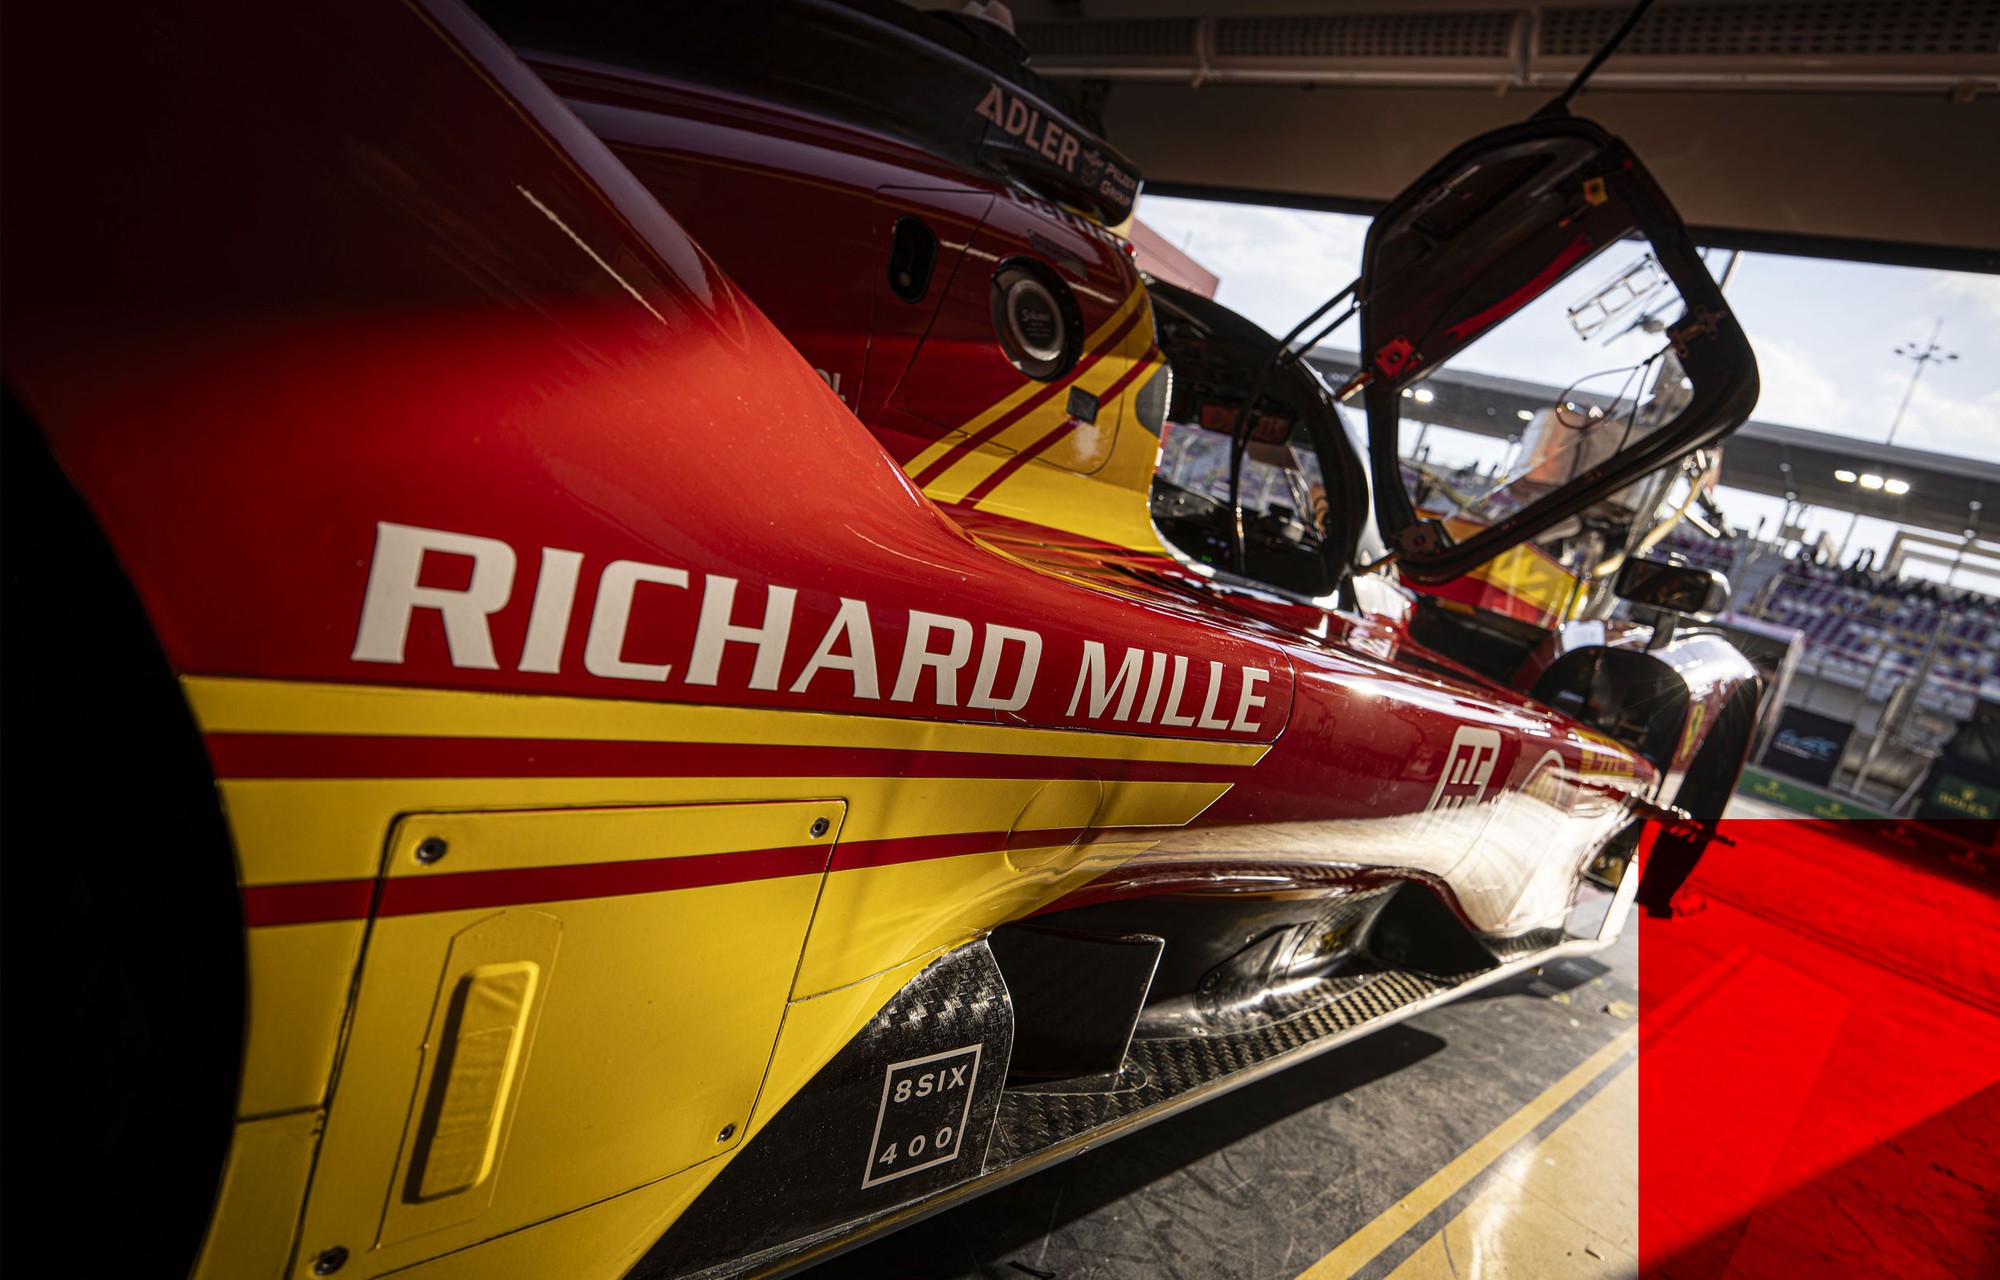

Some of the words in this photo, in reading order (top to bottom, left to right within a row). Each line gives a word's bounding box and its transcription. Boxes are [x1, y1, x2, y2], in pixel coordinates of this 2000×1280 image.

[974, 81, 1081, 173] ADLER
[349, 520, 1043, 712] RICHARD
[1066, 639, 1271, 734] MILLE
[893, 1064, 968, 1103] 8SIX
[878, 1126, 953, 1165] 400
